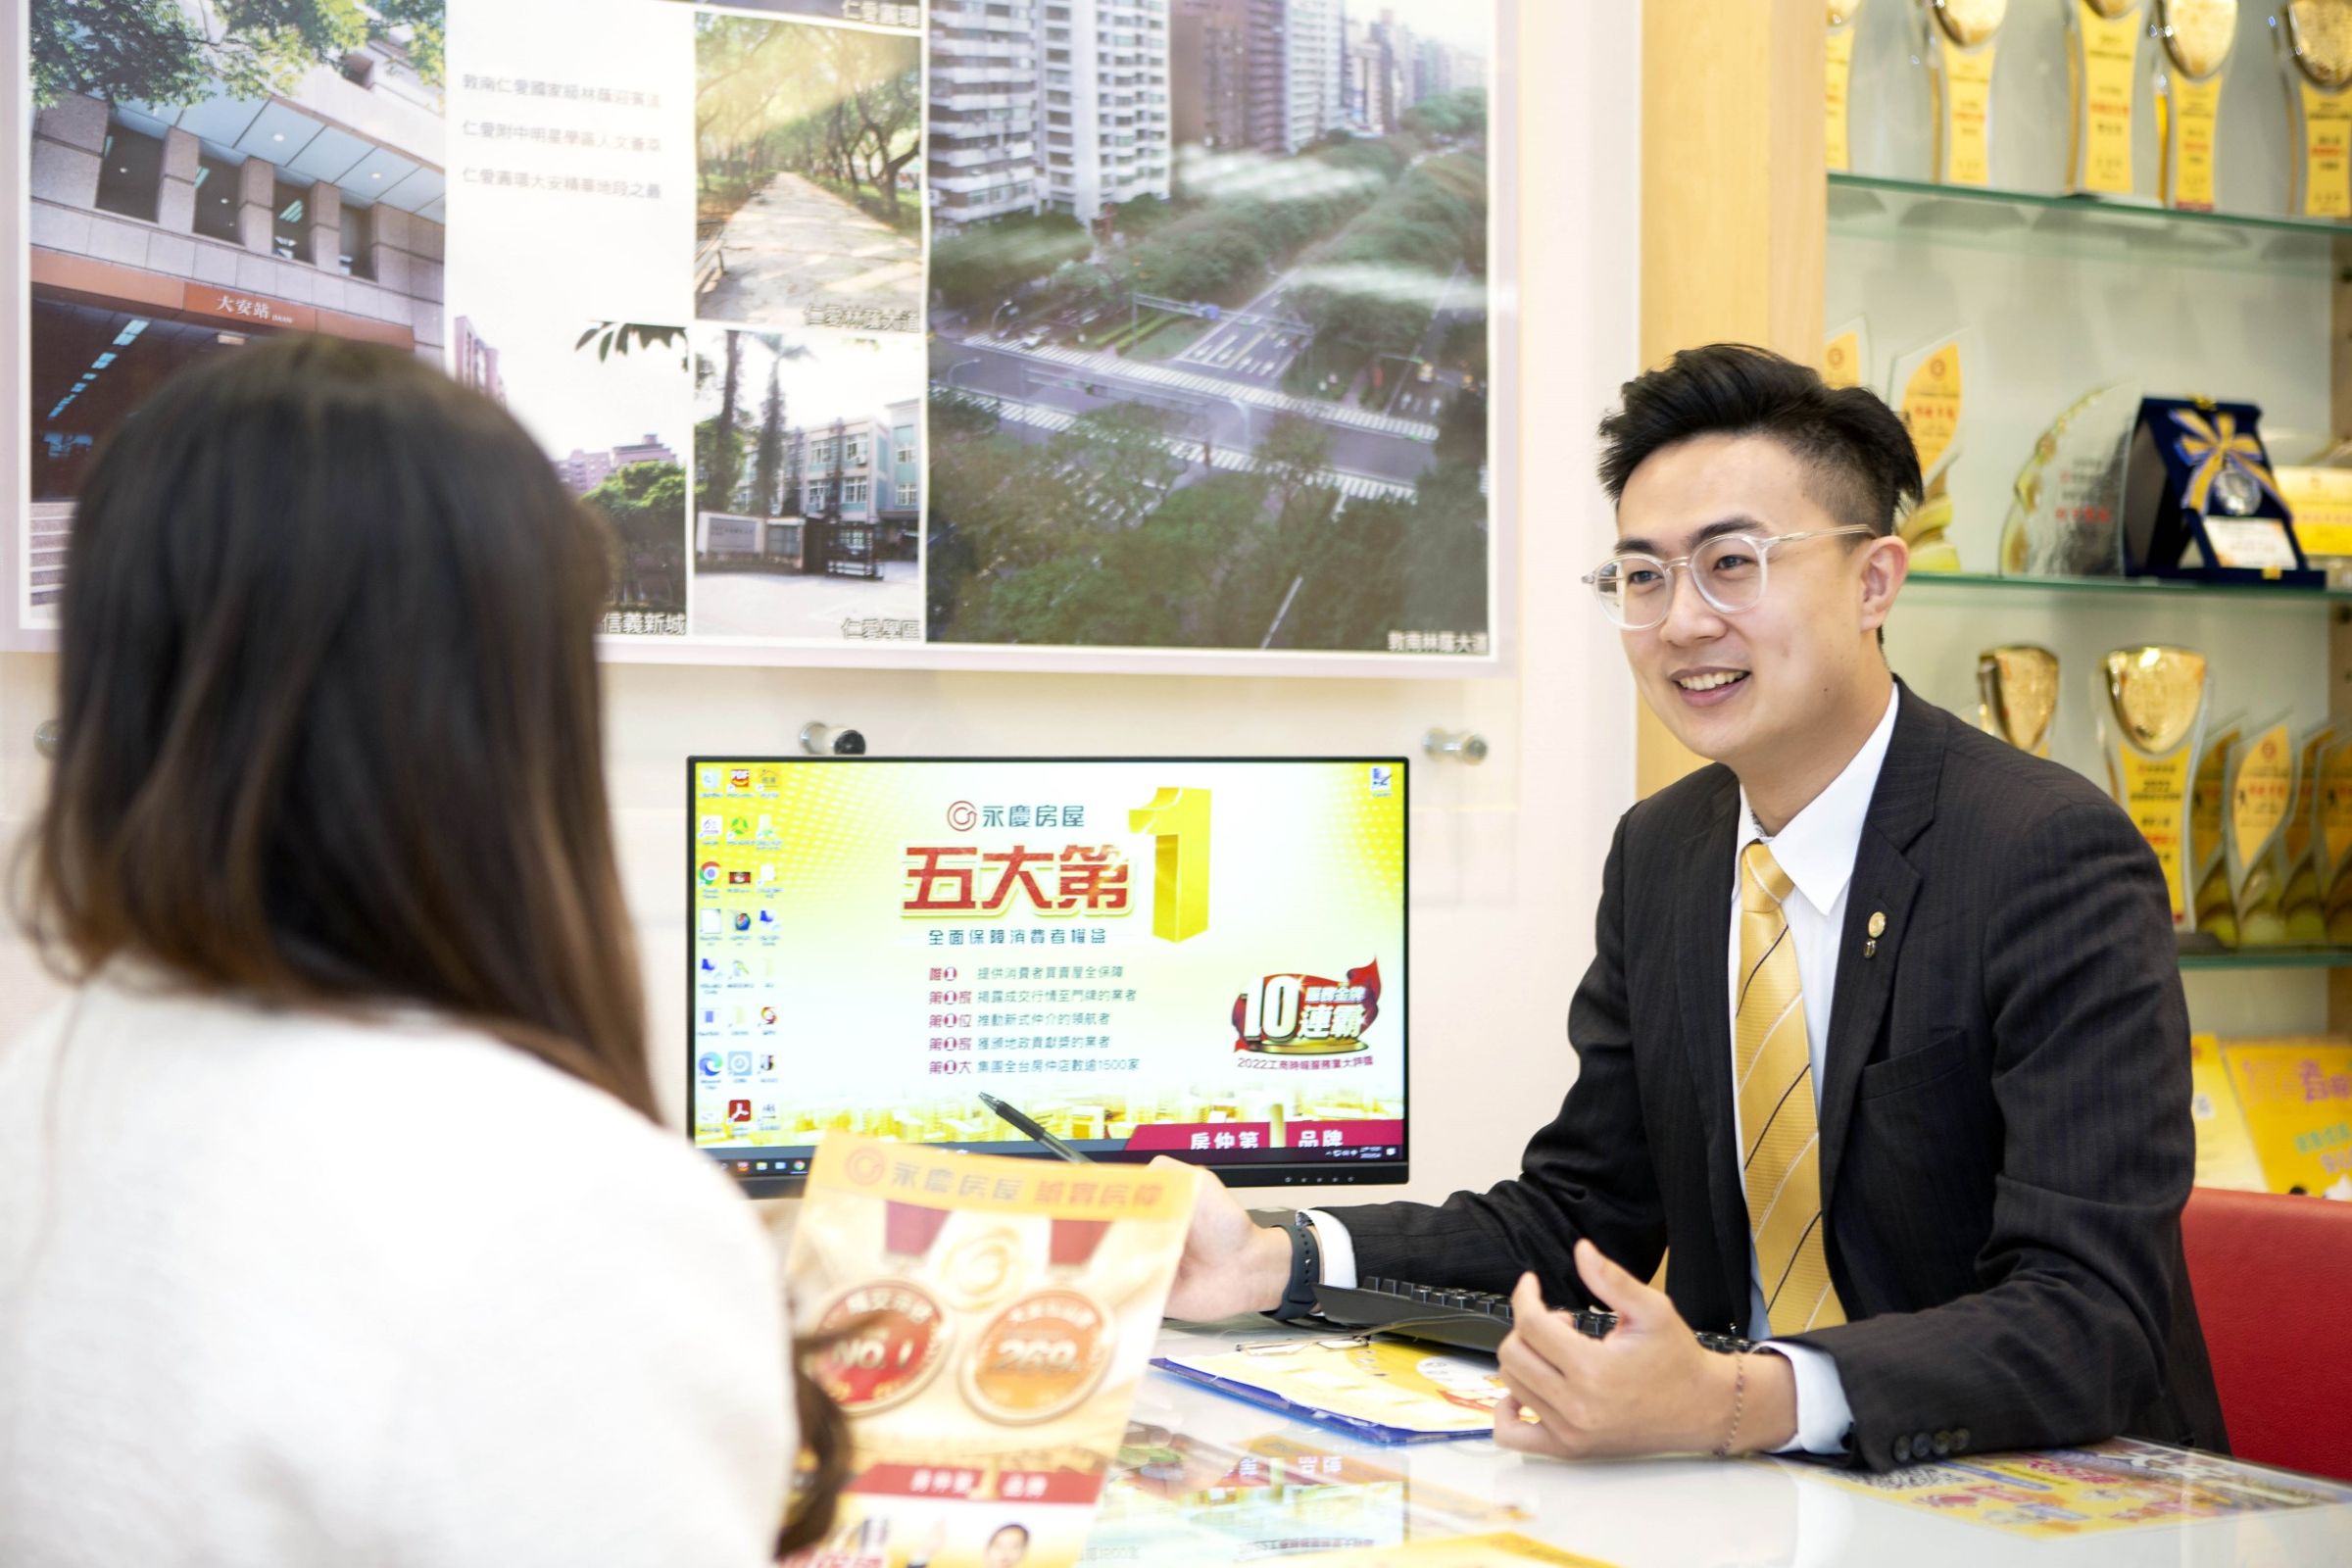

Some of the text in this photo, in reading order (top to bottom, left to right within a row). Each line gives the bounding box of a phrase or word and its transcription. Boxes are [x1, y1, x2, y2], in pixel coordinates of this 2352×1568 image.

[217, 295, 270, 319] 大安站
[601, 612, 686, 636] 信義新城
[841, 617, 920, 642] 仁愛學區
[983, 806, 1085, 828] 永慶房屋
[929, 929, 1106, 946] 全面保障消費者權益
